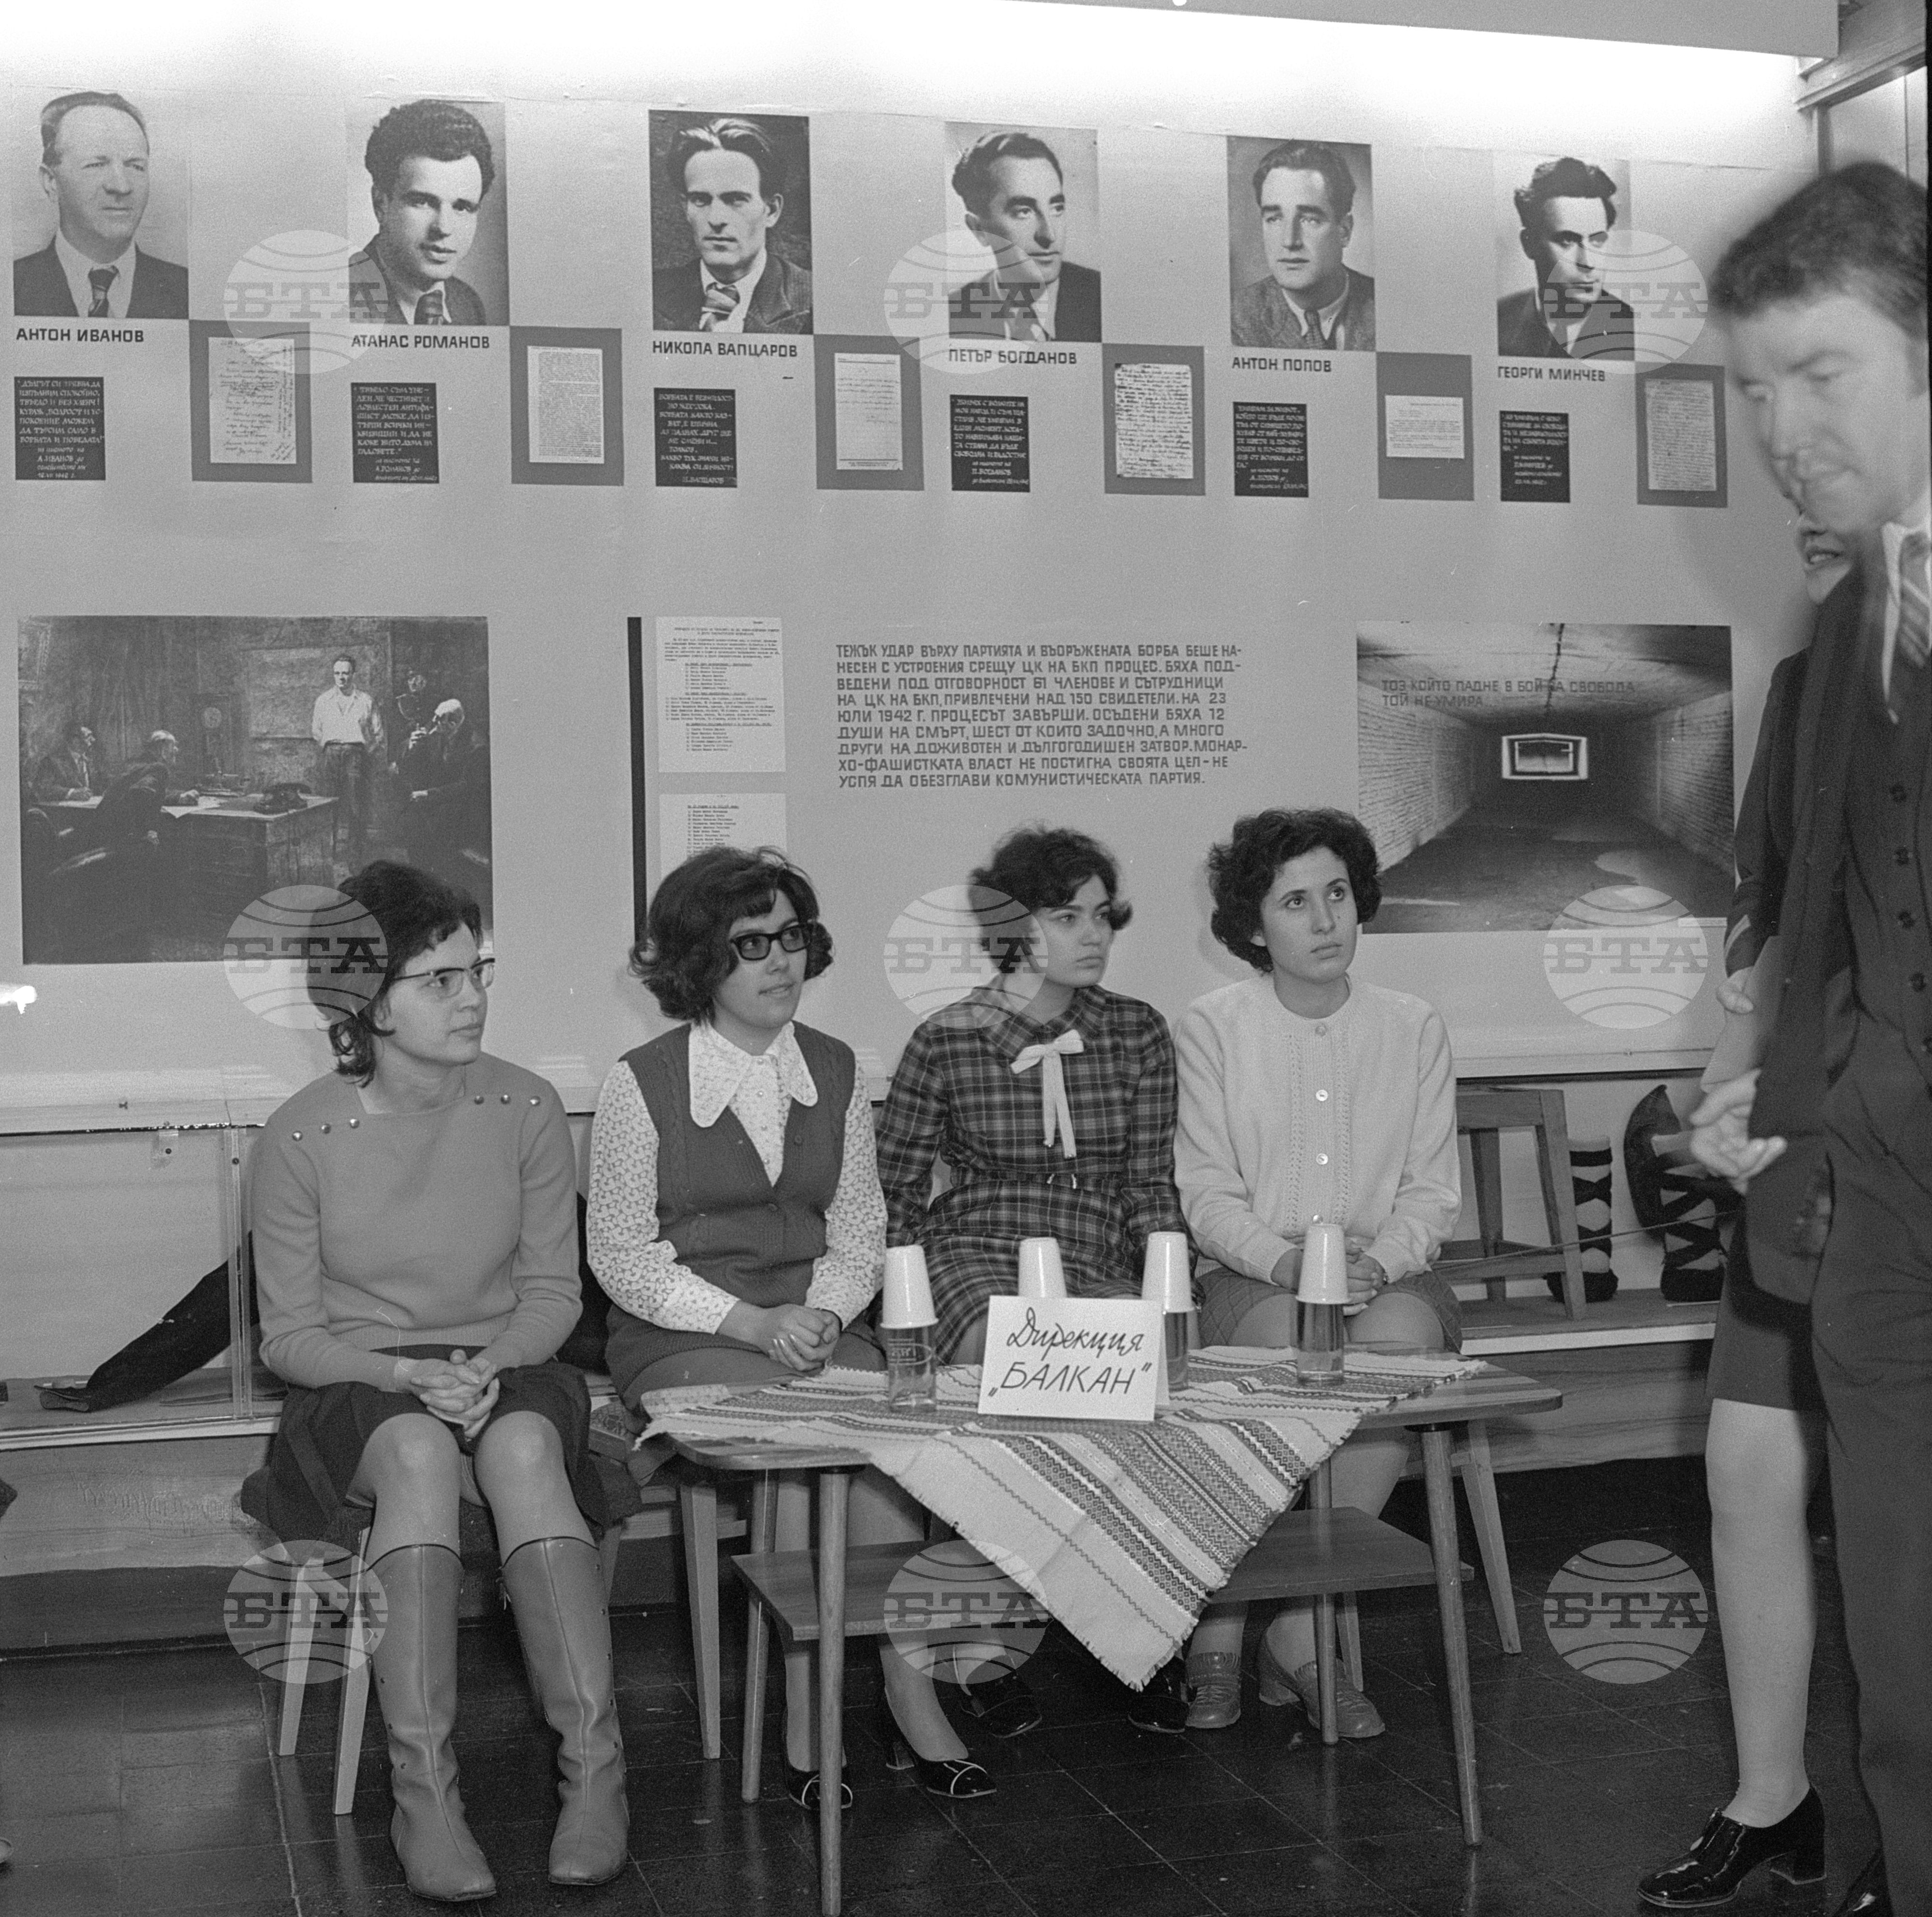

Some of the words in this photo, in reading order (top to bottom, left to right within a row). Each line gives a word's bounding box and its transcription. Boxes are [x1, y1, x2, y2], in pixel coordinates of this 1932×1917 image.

[16, 328, 71, 342] АНТОН
[77, 329, 144, 343] ИВАНОВ
[351, 334, 409, 348] АТАНАС
[414, 335, 490, 349] РОМАНОВ
[653, 341, 713, 355] НИКОЛА
[717, 342, 797, 357] ВАПЦАРОВ
[949, 348, 992, 363] ПЕТЪР
[998, 350, 1077, 365] БОГДАНОВ
[1232, 356, 1278, 371] АНТОН
[1283, 358, 1332, 372] ПОПОВ
[1498, 366, 1543, 380] ГЕОРГИ
[1548, 368, 1606, 382] МИНЧЕВ
[836, 644, 877, 658] ТЕЖЪК
[881, 644, 914, 657] УДАР
[921, 645, 959, 657] ВЪРХУ
[963, 644, 1022, 657] ПАРТИЯТА
[1027, 645, 1036, 656] И
[1040, 644, 1131, 657] ВЪОРЪЖЕНАТА
[1137, 644, 1179, 657] БОРБА
[1186, 644, 1218, 657] БЕШЕ
[837, 662, 877, 673] НЕСЕН
[881, 661, 889, 673] С
[894, 661, 964, 673] УСТРОЕНИЯ
[969, 661, 1015, 675] СРЕЩУ
[1022, 661, 1042, 675] ЦК
[1048, 661, 1066, 672] НА
[1072, 661, 1098, 672] БКП
[1165, 660, 1198, 672] БЯХА
[837, 678, 890, 690] ВЕДЕНИ
[898, 678, 929, 690] ПОД
[935, 677, 1026, 689] ОТГОВОРНОСТ
[1033, 677, 1046, 689] 61
[1054, 677, 1114, 689] ЧЛЕНОВЕ
[1120, 677, 1128, 688] И
[1135, 677, 1223, 690] СЪТРУДНИЦИ
[1456, 680, 1498, 692] ПАДНЕ
[1569, 681, 1635, 693] СВОБОДА
[838, 694, 856, 706] НА
[865, 694, 885, 709] ЦК
[890, 694, 908, 705] НА
[944, 693, 1029, 705] ПРИВЛЕЧЕНИ
[1037, 693, 1065, 705] НАД
[1070, 693, 1092, 705] 150
[1182, 693, 1200, 704] НА
[1209, 692, 1226, 704] 23
[1382, 693, 1408, 707] ТОЙ
[838, 710, 871, 723] ЮЛИ
[878, 710, 911, 722] 1942
[931, 709, 1005, 724] ПРОЦЕСЪТ
[1093, 709, 1159, 721] ОСЪДЕНИ
[1166, 708, 1201, 720] БЯХА
[1209, 708, 1224, 721] 12
[837, 726, 882, 739] ДУШИ
[890, 726, 909, 738] НА
[973, 725, 1010, 738] ШЕСТ
[1016, 725, 1032, 737] ОТ
[1037, 725, 1081, 737] КОИТО
[1174, 724, 1224, 736] МНОГО
[838, 743, 882, 755] ДРУГИ
[891, 743, 910, 754] НА
[914, 742, 1001, 754] ДОЖИВОТЕН
[1008, 742, 1016, 753] И
[1021, 741, 1134, 753] ДЪЛГОГОДИШЕН
[838, 757, 964, 772] ХО-ФАШИСТКАТА
[969, 758, 1012, 770] ВЛАСТ
[1019, 757, 1035, 769] НЕ
[1041, 757, 1111, 769] ПОСТИГНА
[1118, 756, 1169, 768] СВОЯТА
[839, 775, 876, 788] УСПЯ
[881, 775, 903, 788] ДА
[909, 774, 990, 787] ОБЕЗГЛАВИ
[996, 773, 1142, 786] КОМУНИСТИЧЕСКАТА
[1007, 1307, 1145, 1360] Дирекция
